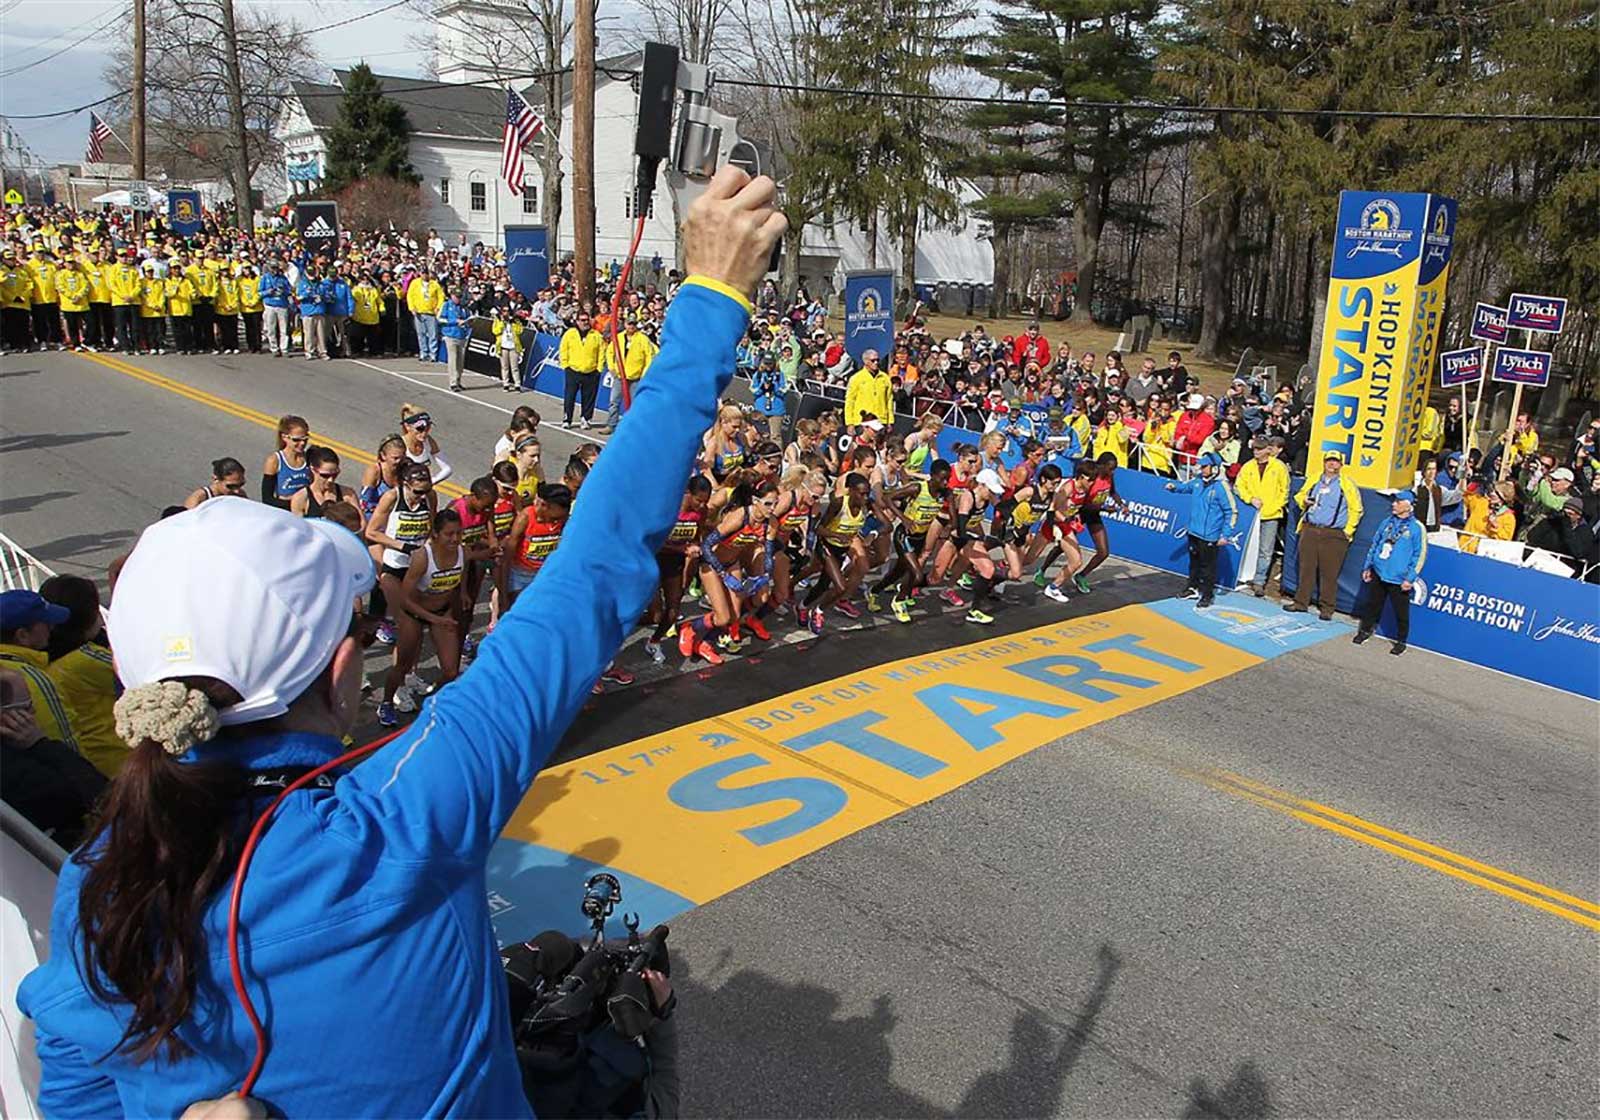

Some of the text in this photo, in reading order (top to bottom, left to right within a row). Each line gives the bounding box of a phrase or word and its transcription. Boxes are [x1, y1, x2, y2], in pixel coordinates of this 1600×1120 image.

[132, 195, 148, 207] 85
[303, 229, 336, 238] adidas
[1479, 310, 1506, 328] Lynch
[1515, 300, 1557, 318] Lynch
[1321, 285, 1373, 465] START
[1361, 299, 1401, 451] HOPKINTON
[1447, 353, 1479, 375] Lynch
[1501, 354, 1543, 372] Lynch
[1395, 290, 1428, 470] MARATHON
[1409, 311, 1436, 445] BOSTON
[1128, 501, 1169, 520] BOSTON
[1427, 596, 1524, 632] MARATHON
[1431, 583, 1525, 617] 2013 BOSTON
[1533, 616, 1574, 641] John
[580, 620, 1111, 785] 117TH BOSTON MARATHON 2013
[667, 632, 1205, 847] START
